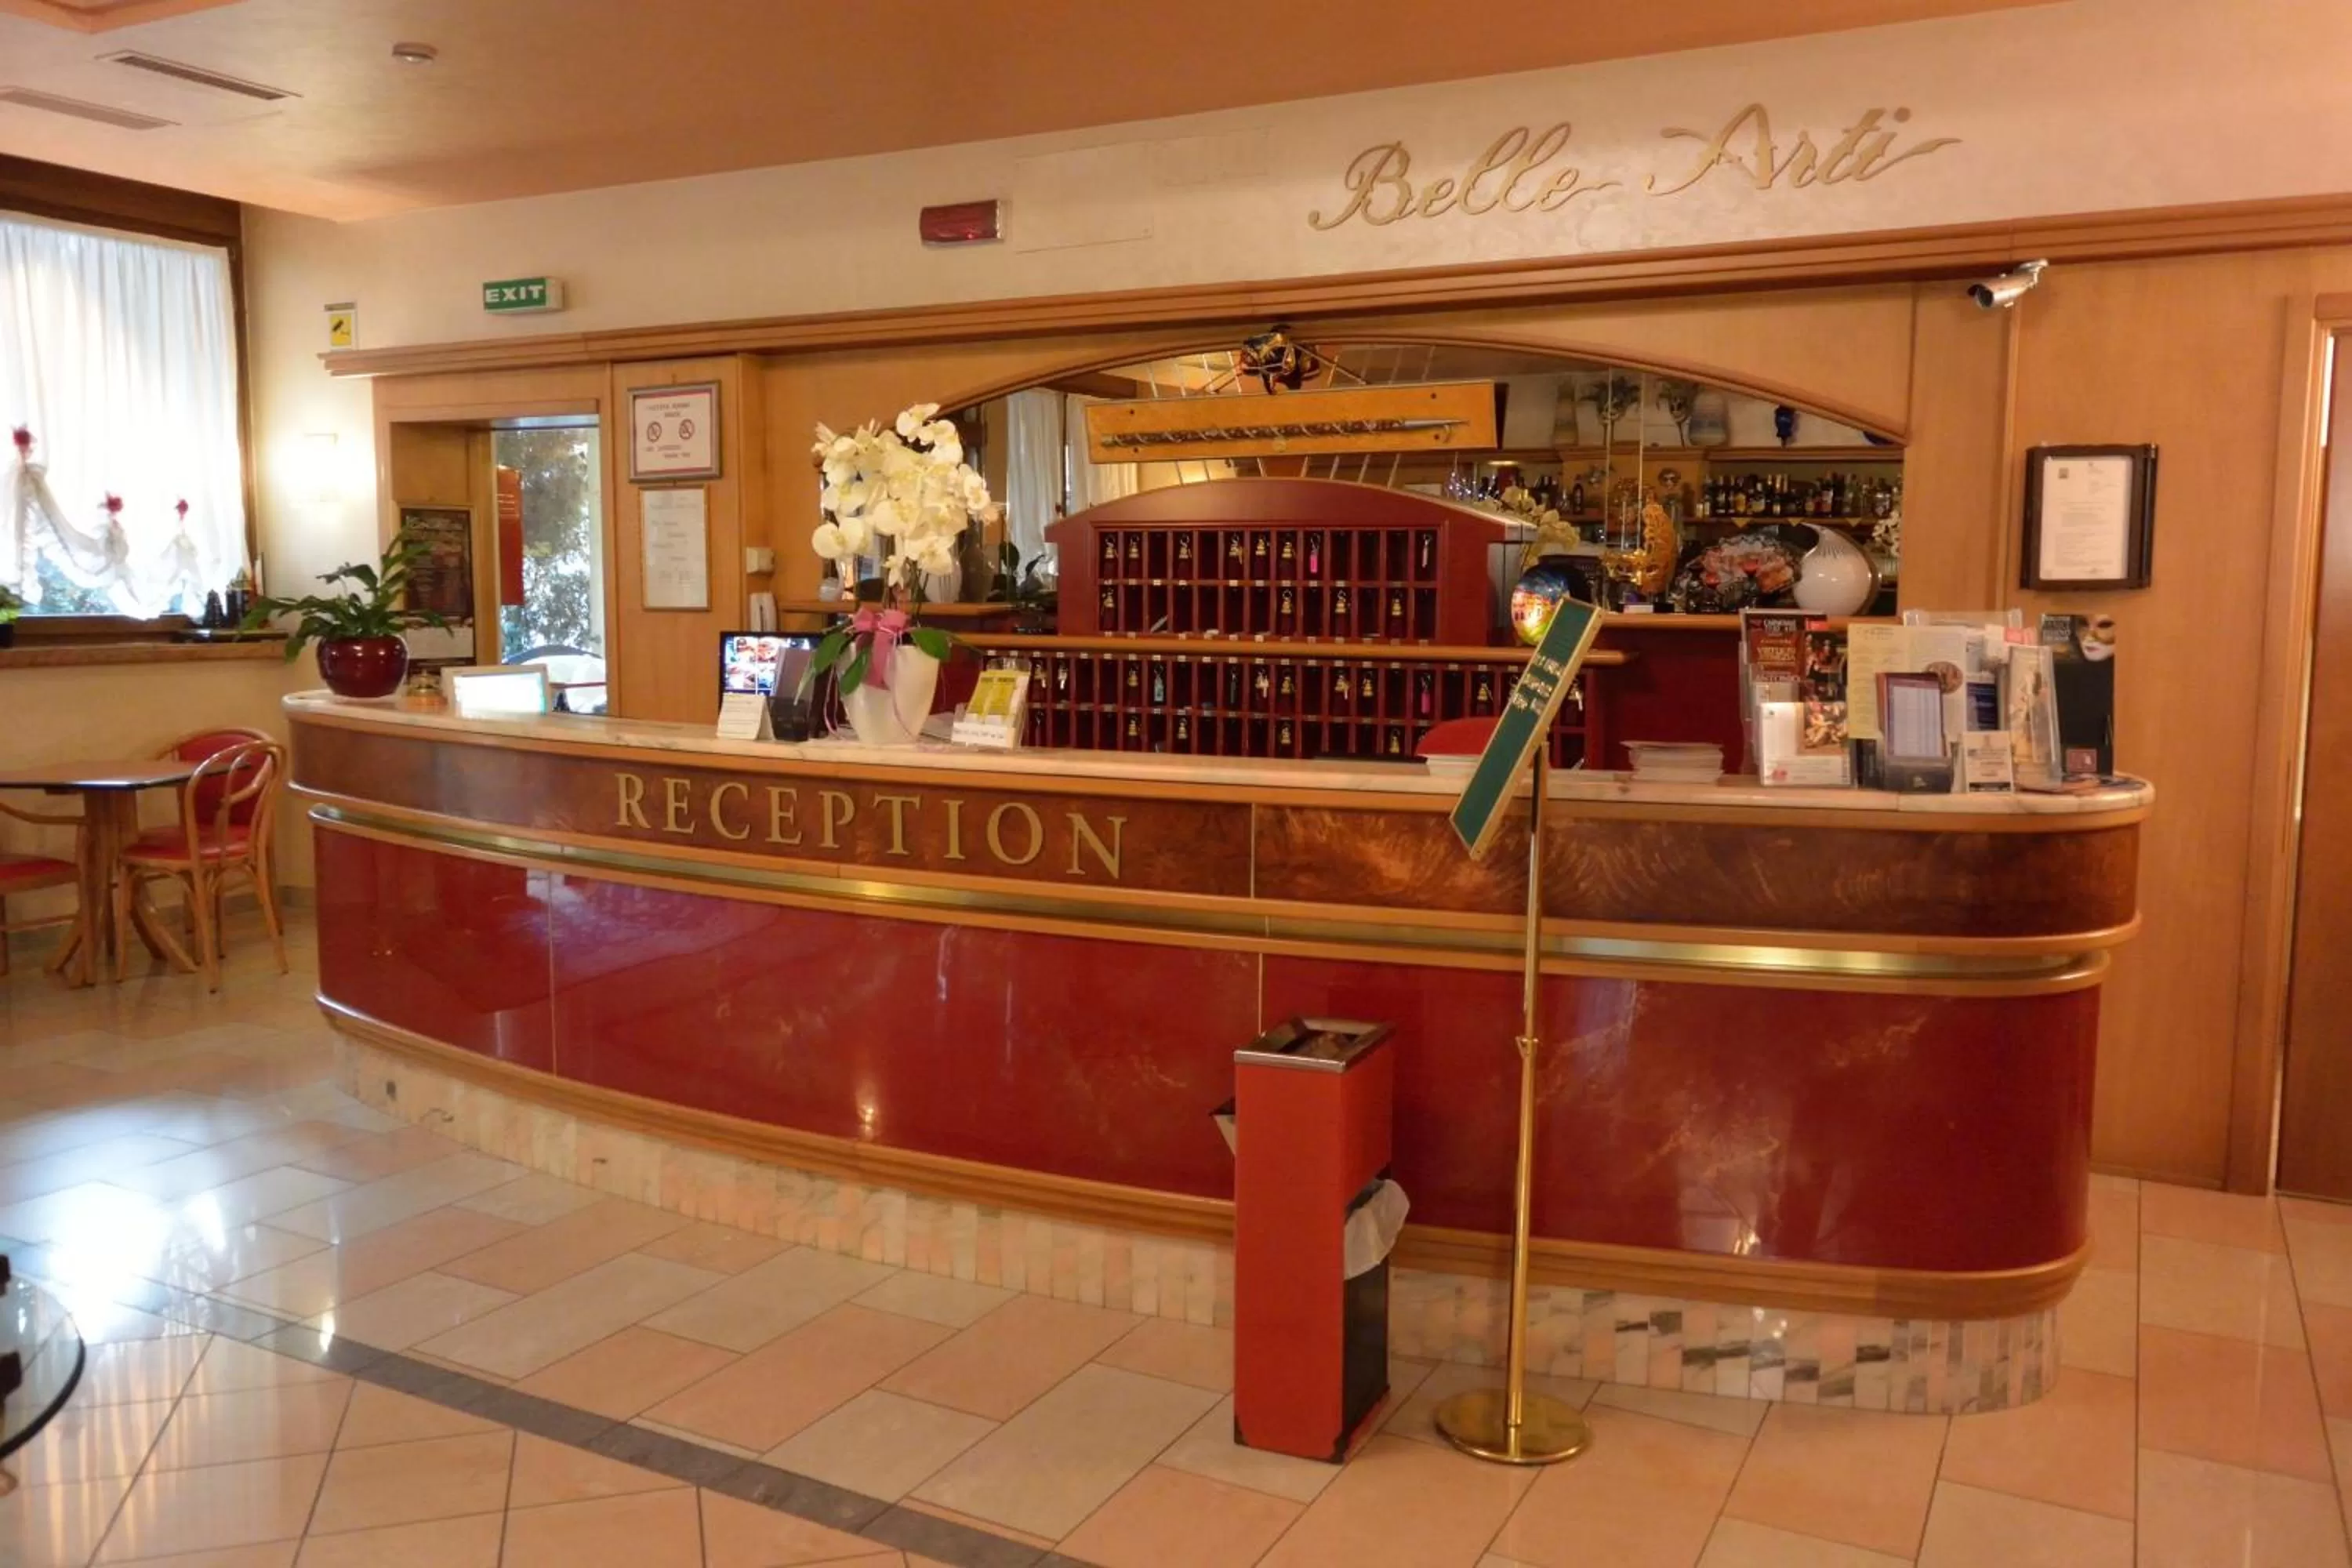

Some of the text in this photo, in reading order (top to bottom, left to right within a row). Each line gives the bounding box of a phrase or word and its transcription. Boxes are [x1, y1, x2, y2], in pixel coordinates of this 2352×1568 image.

[1308, 103, 1962, 230] Belle Arti
[485, 285, 544, 303] EXIT
[615, 772, 1127, 879] RECEPTION
